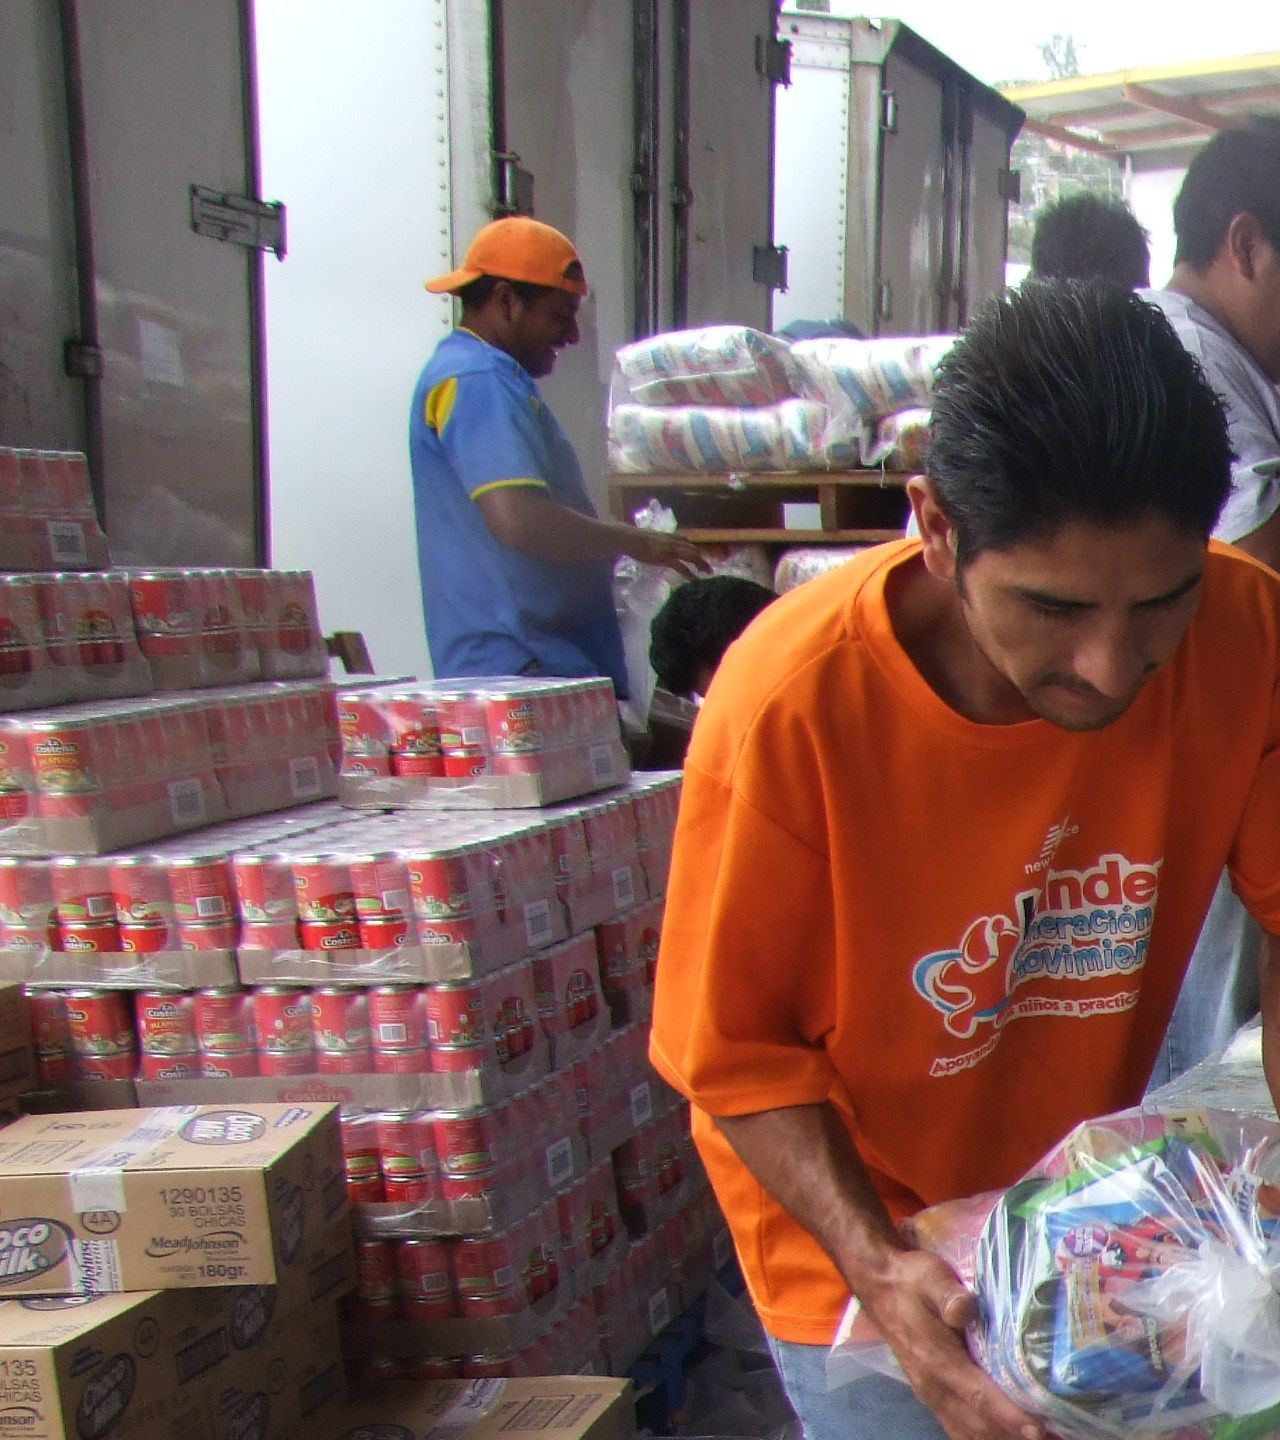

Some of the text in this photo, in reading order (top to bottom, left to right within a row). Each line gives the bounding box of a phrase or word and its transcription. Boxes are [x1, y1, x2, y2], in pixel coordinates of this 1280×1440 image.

[160, 1186, 242, 1204] 1290135
[169, 1204, 246, 1217] 30 BOLSAS
[195, 1216, 247, 1227] CHICAS
[198, 1266, 247, 1279] 180gr.
